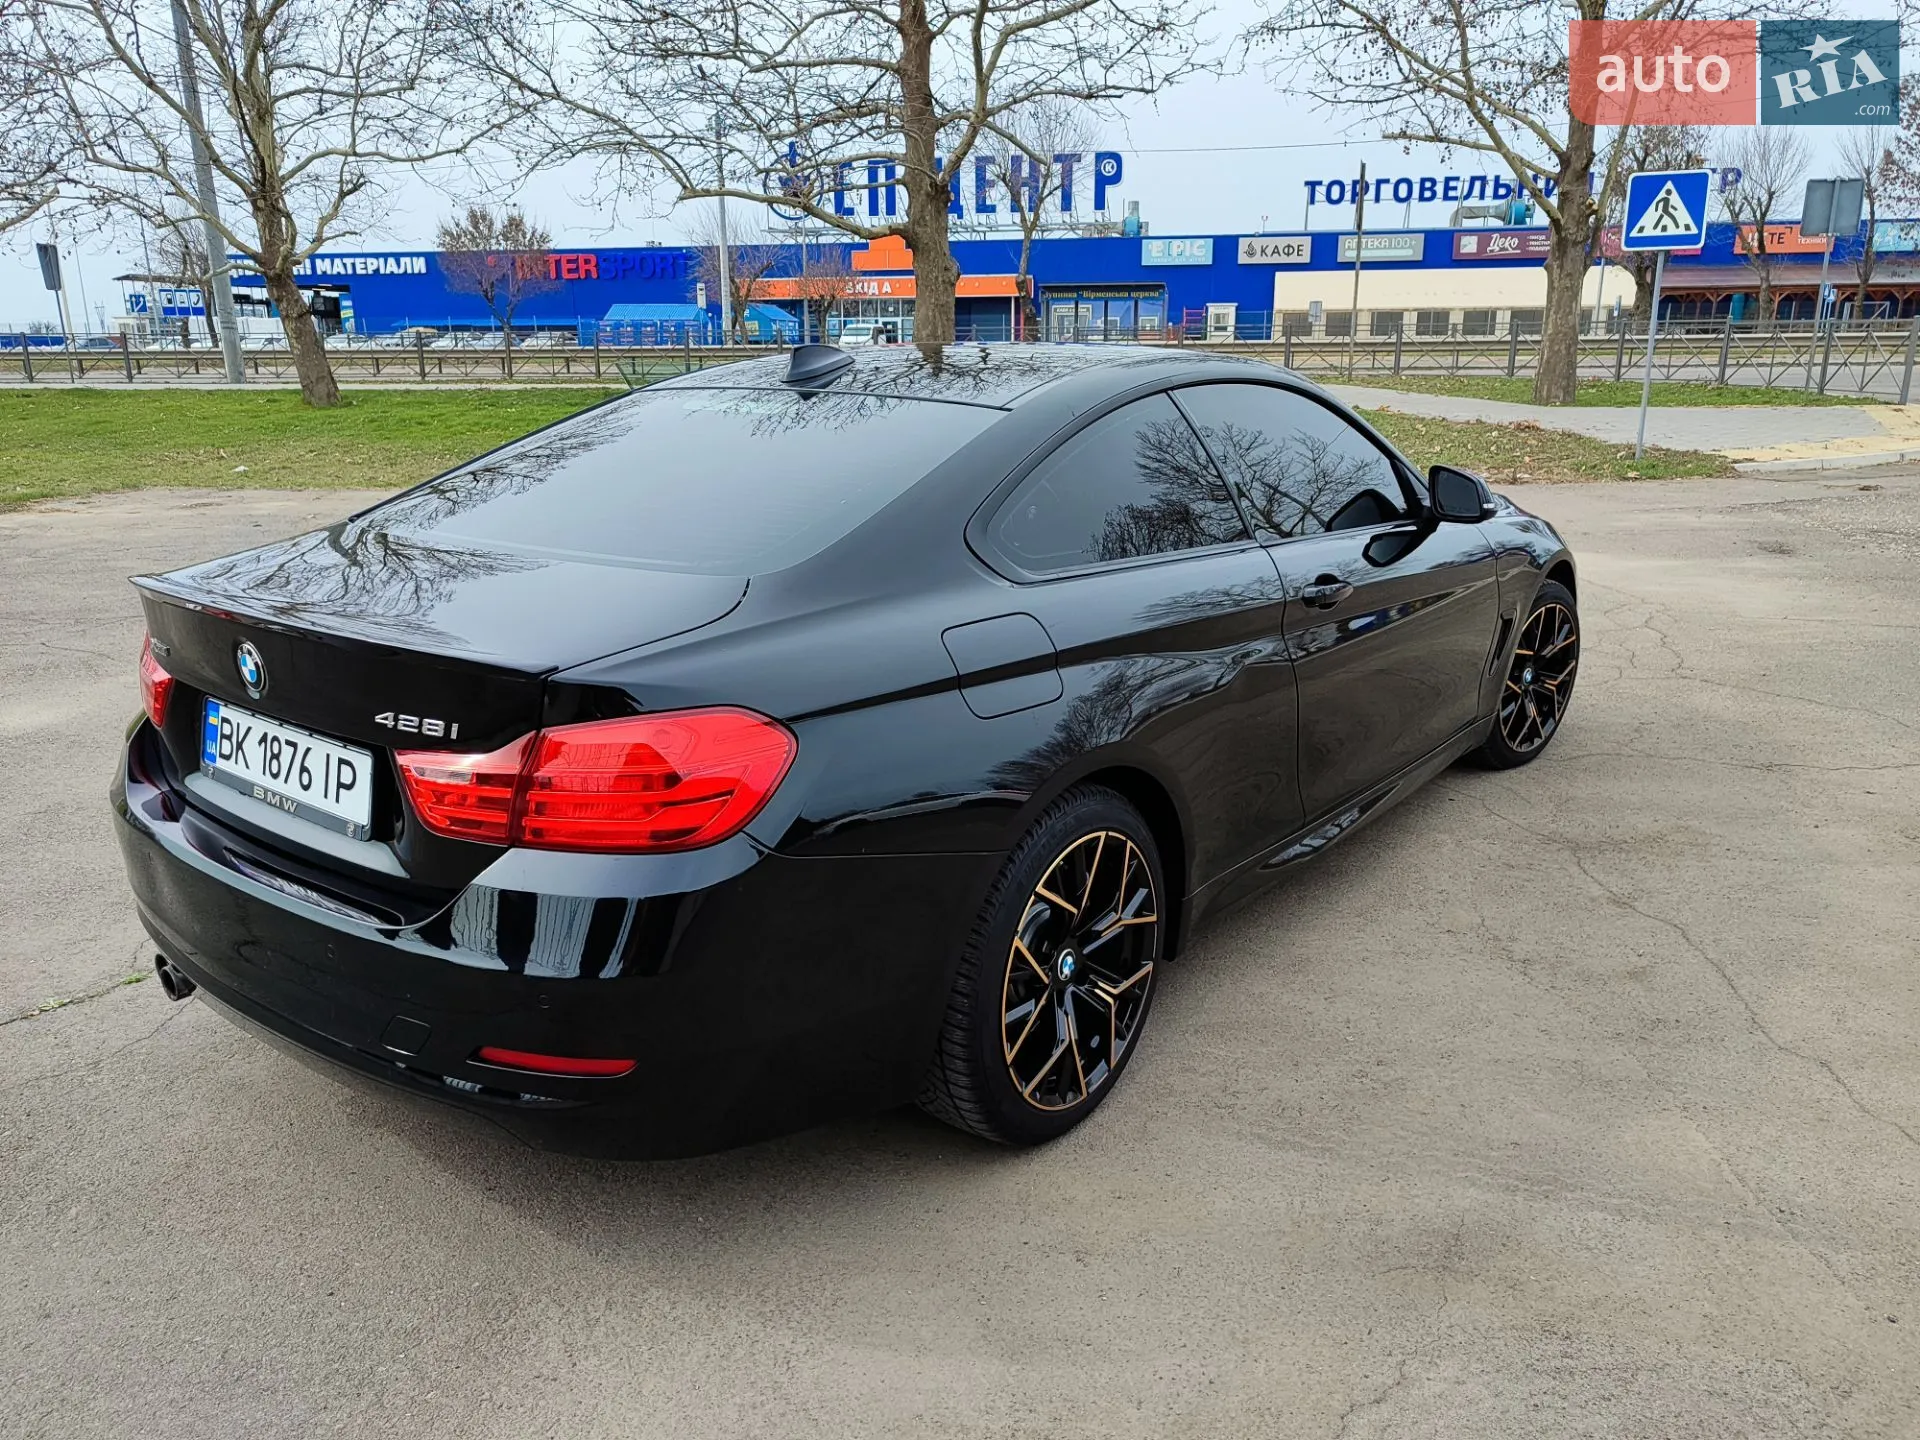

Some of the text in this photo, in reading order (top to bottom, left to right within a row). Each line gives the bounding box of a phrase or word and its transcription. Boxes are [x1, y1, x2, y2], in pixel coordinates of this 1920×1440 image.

[833, 150, 1123, 220] ЕПЦЕНТР
[1260, 243, 1305, 258] КАФЕ
[1344, 237, 1417, 249] АПТЕКА 100+
[1486, 232, 1519, 254] Деко
[315, 256, 427, 275] МАТЕРІАЛИ
[206, 740, 216, 755] UA
[257, 731, 312, 791] 1876
[253, 785, 298, 813] BMW
